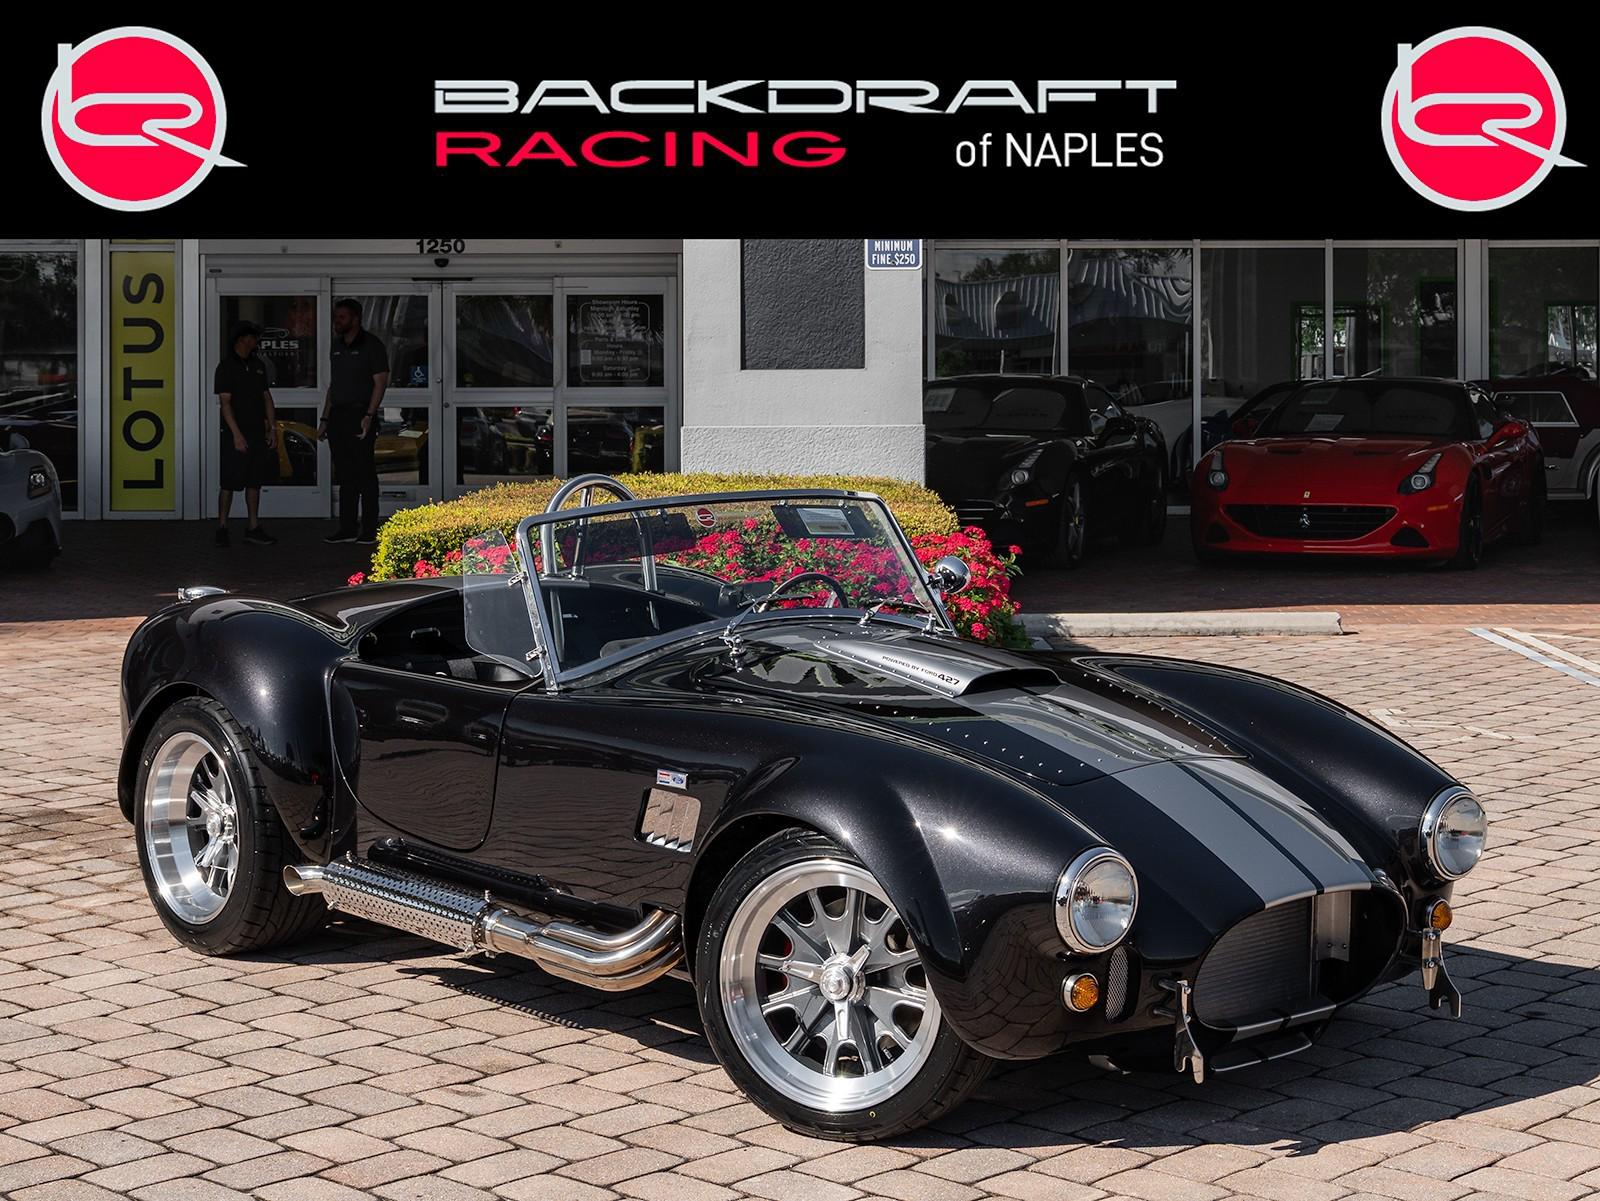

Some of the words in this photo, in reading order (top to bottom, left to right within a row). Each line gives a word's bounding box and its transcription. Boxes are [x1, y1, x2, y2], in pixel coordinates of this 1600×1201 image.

[416, 239, 465, 254] 1250
[874, 240, 913, 251] MINIMUM
[872, 253, 891, 264] FINE
[894, 253, 915, 265] $250
[123, 272, 164, 489] LOTUS
[882, 656, 910, 667] POWERED
[921, 667, 938, 676] FORD
[938, 673, 960, 685] 427
